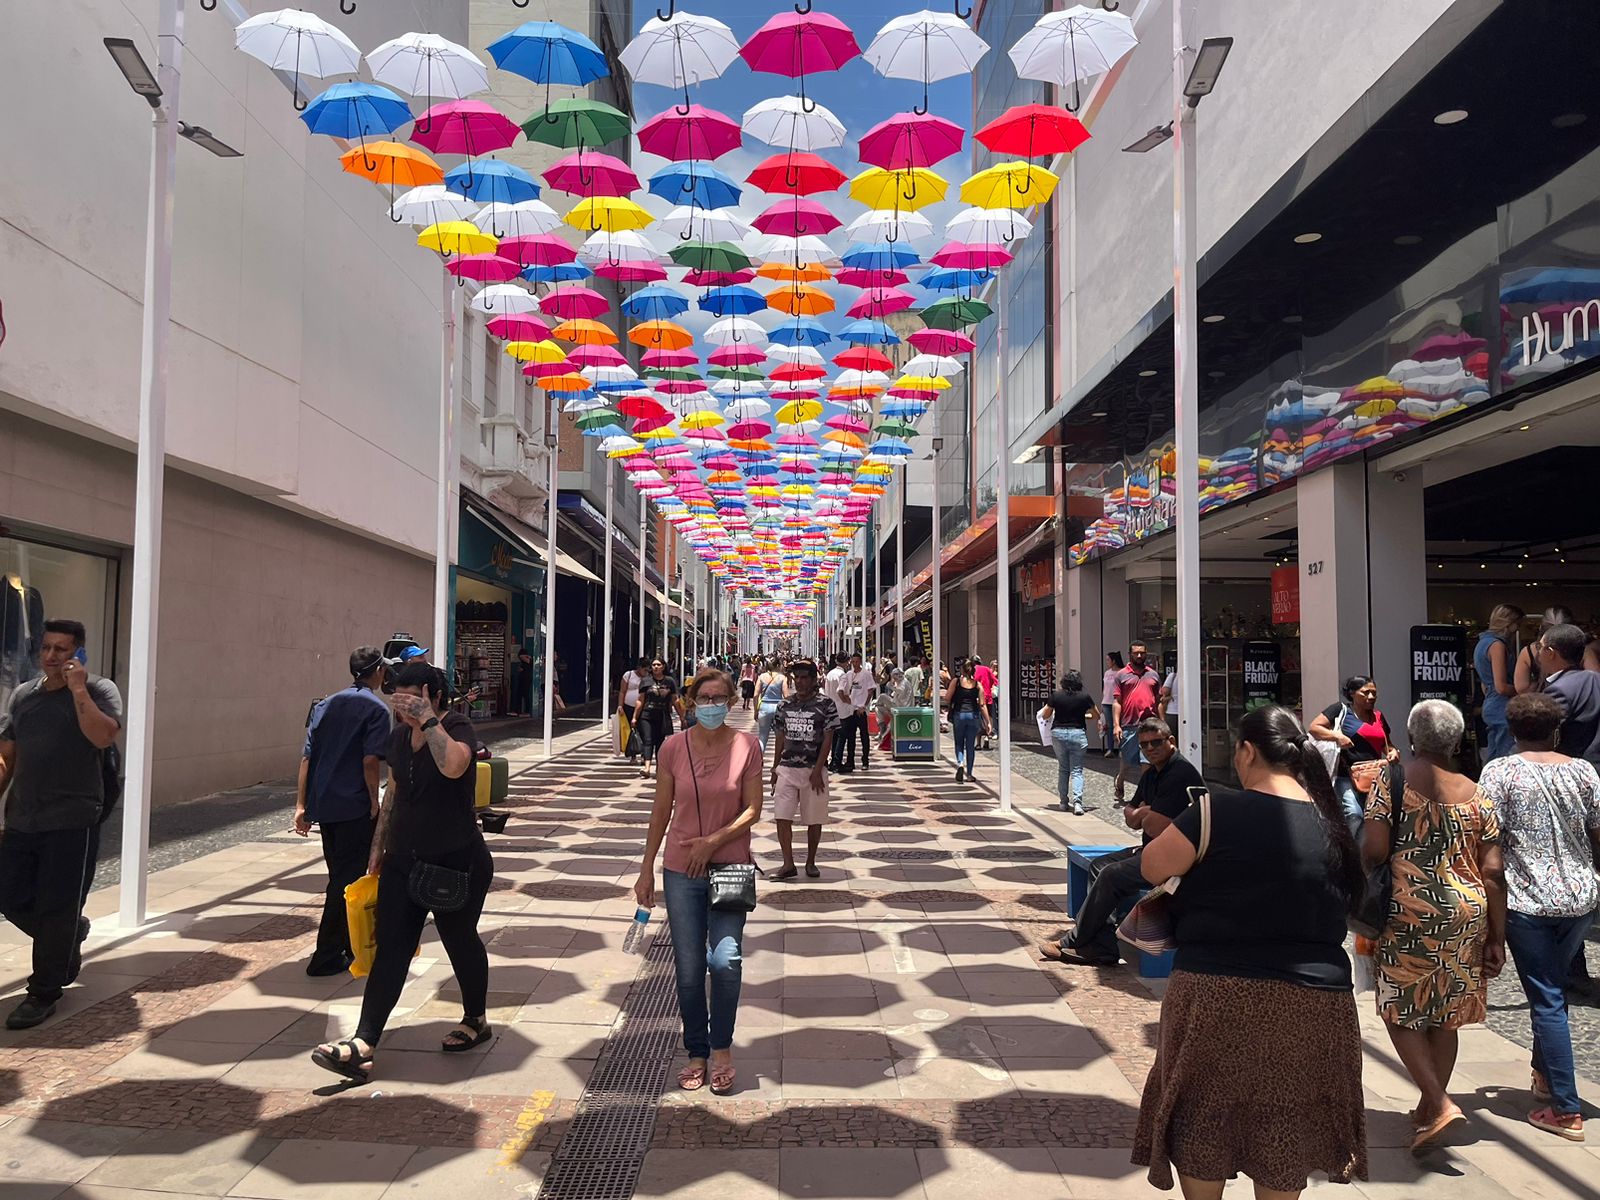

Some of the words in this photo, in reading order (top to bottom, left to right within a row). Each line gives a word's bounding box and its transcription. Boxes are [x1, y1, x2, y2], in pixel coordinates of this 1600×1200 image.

[1308, 561, 1323, 576] 527
[920, 620, 933, 660] OUTLET
[1413, 651, 1457, 666] BLACK
[1244, 661, 1275, 672] BLACK
[1414, 666, 1462, 681] FRIDAY
[1029, 664, 1037, 698] BLACK
[1040, 663, 1049, 698] BLACK
[1245, 672, 1279, 684] FRIDAY
[786, 723, 814, 732] CRISTO
